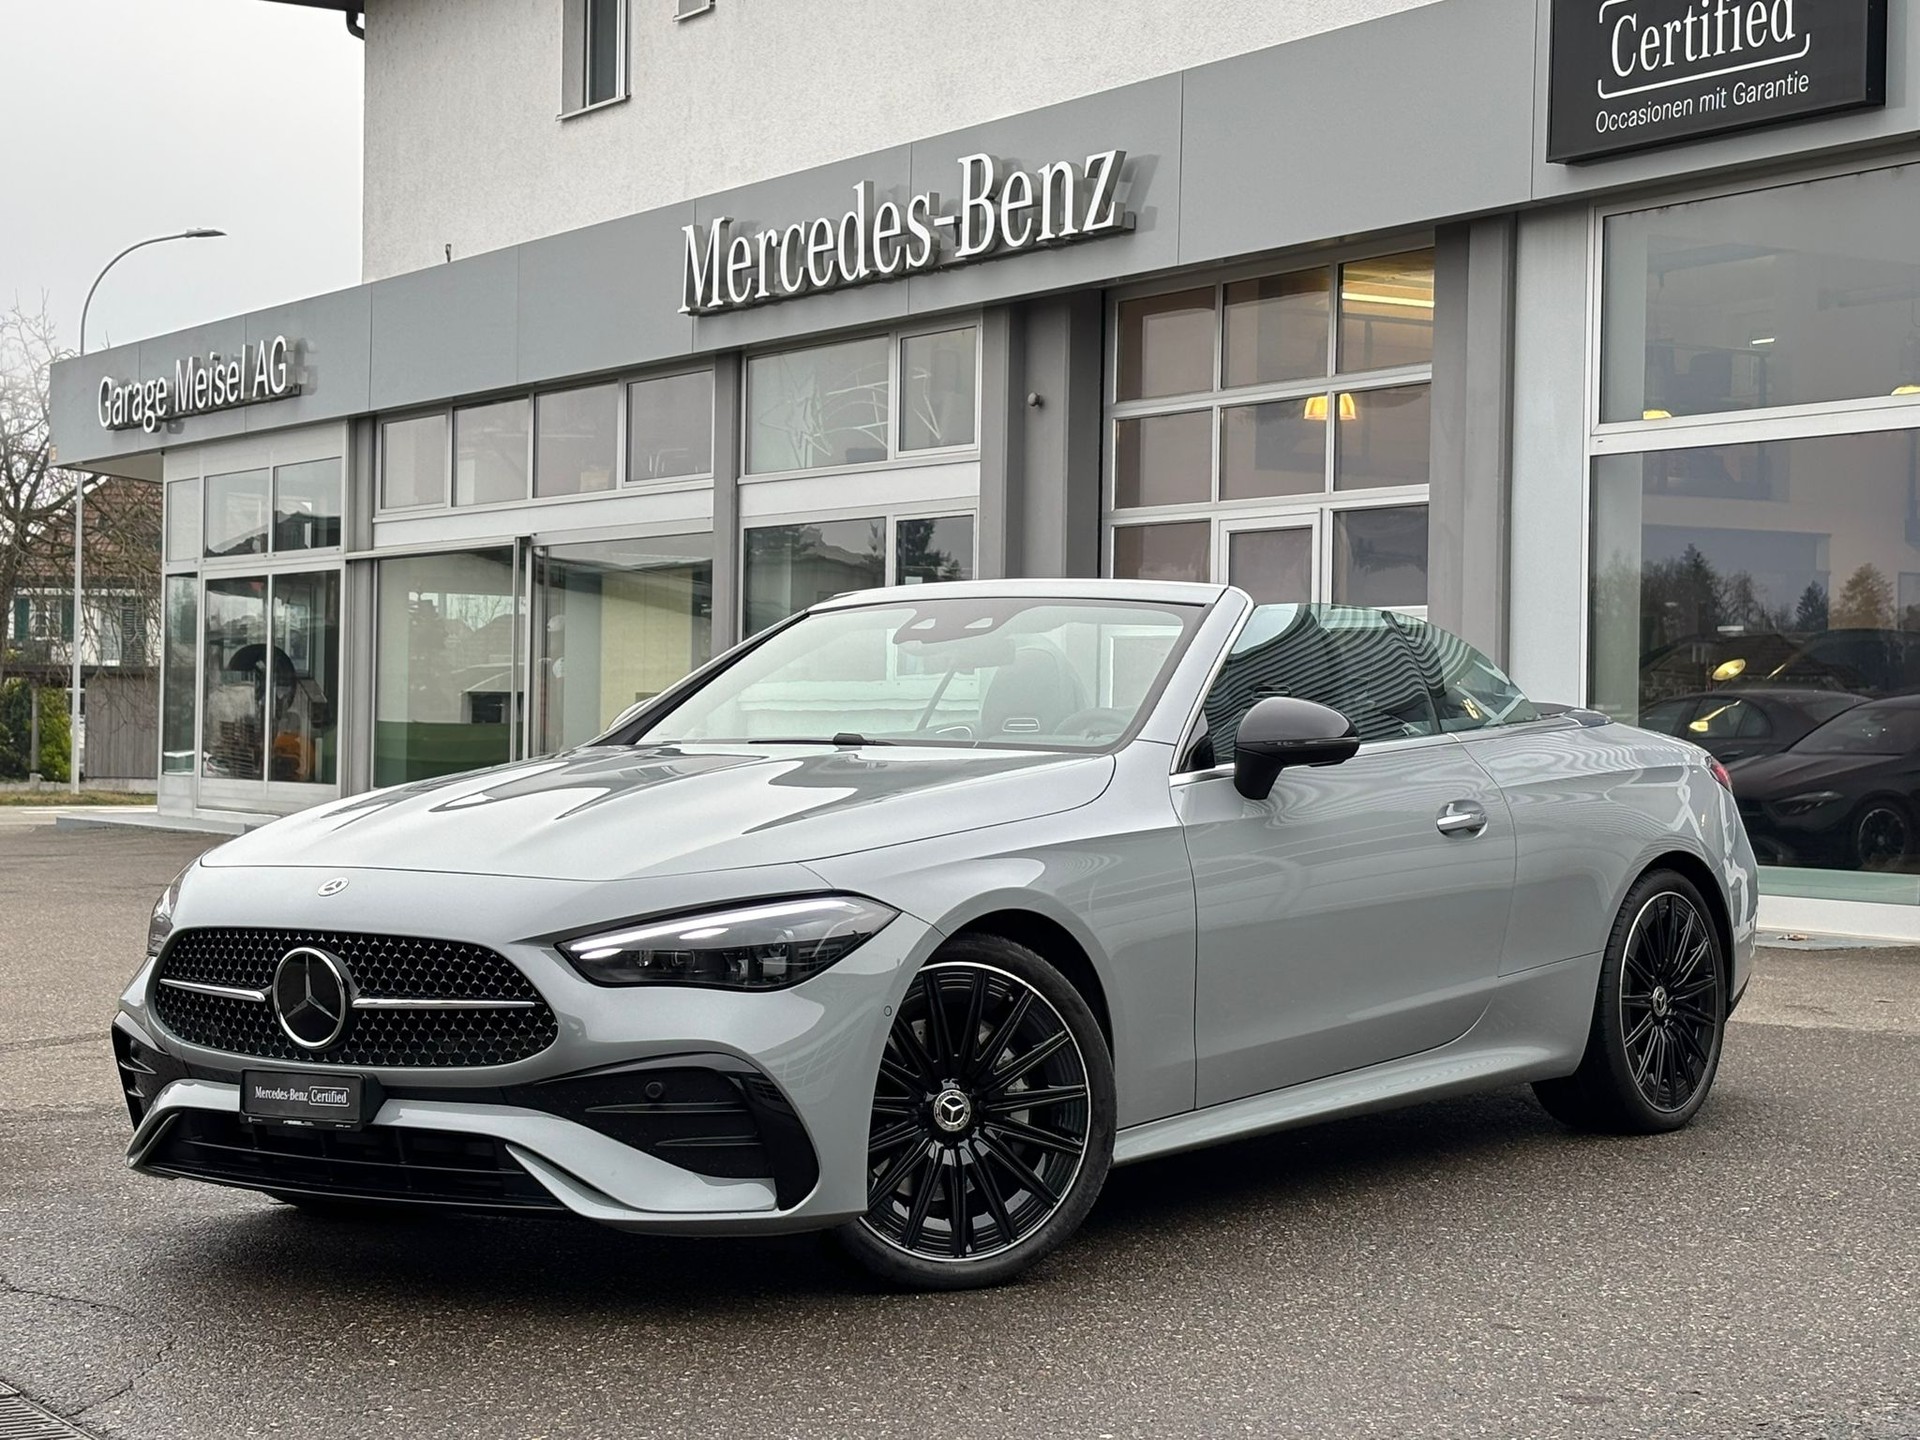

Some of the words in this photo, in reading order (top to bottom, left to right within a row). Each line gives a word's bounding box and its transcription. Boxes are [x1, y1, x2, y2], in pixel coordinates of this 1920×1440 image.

[1611, 0, 1796, 77] Certified
[1595, 98, 1693, 133] Occasionen
[1699, 86, 1727, 113] mit
[1733, 70, 1809, 106] Garantie
[677, 150, 1122, 313] Mercedes-Benz
[98, 375, 167, 433] Garage
[175, 343, 246, 413] Meisel
[252, 335, 287, 397] AG
[254, 1085, 308, 1101] Mercedes-Benz
[311, 1089, 347, 1103] Certified
